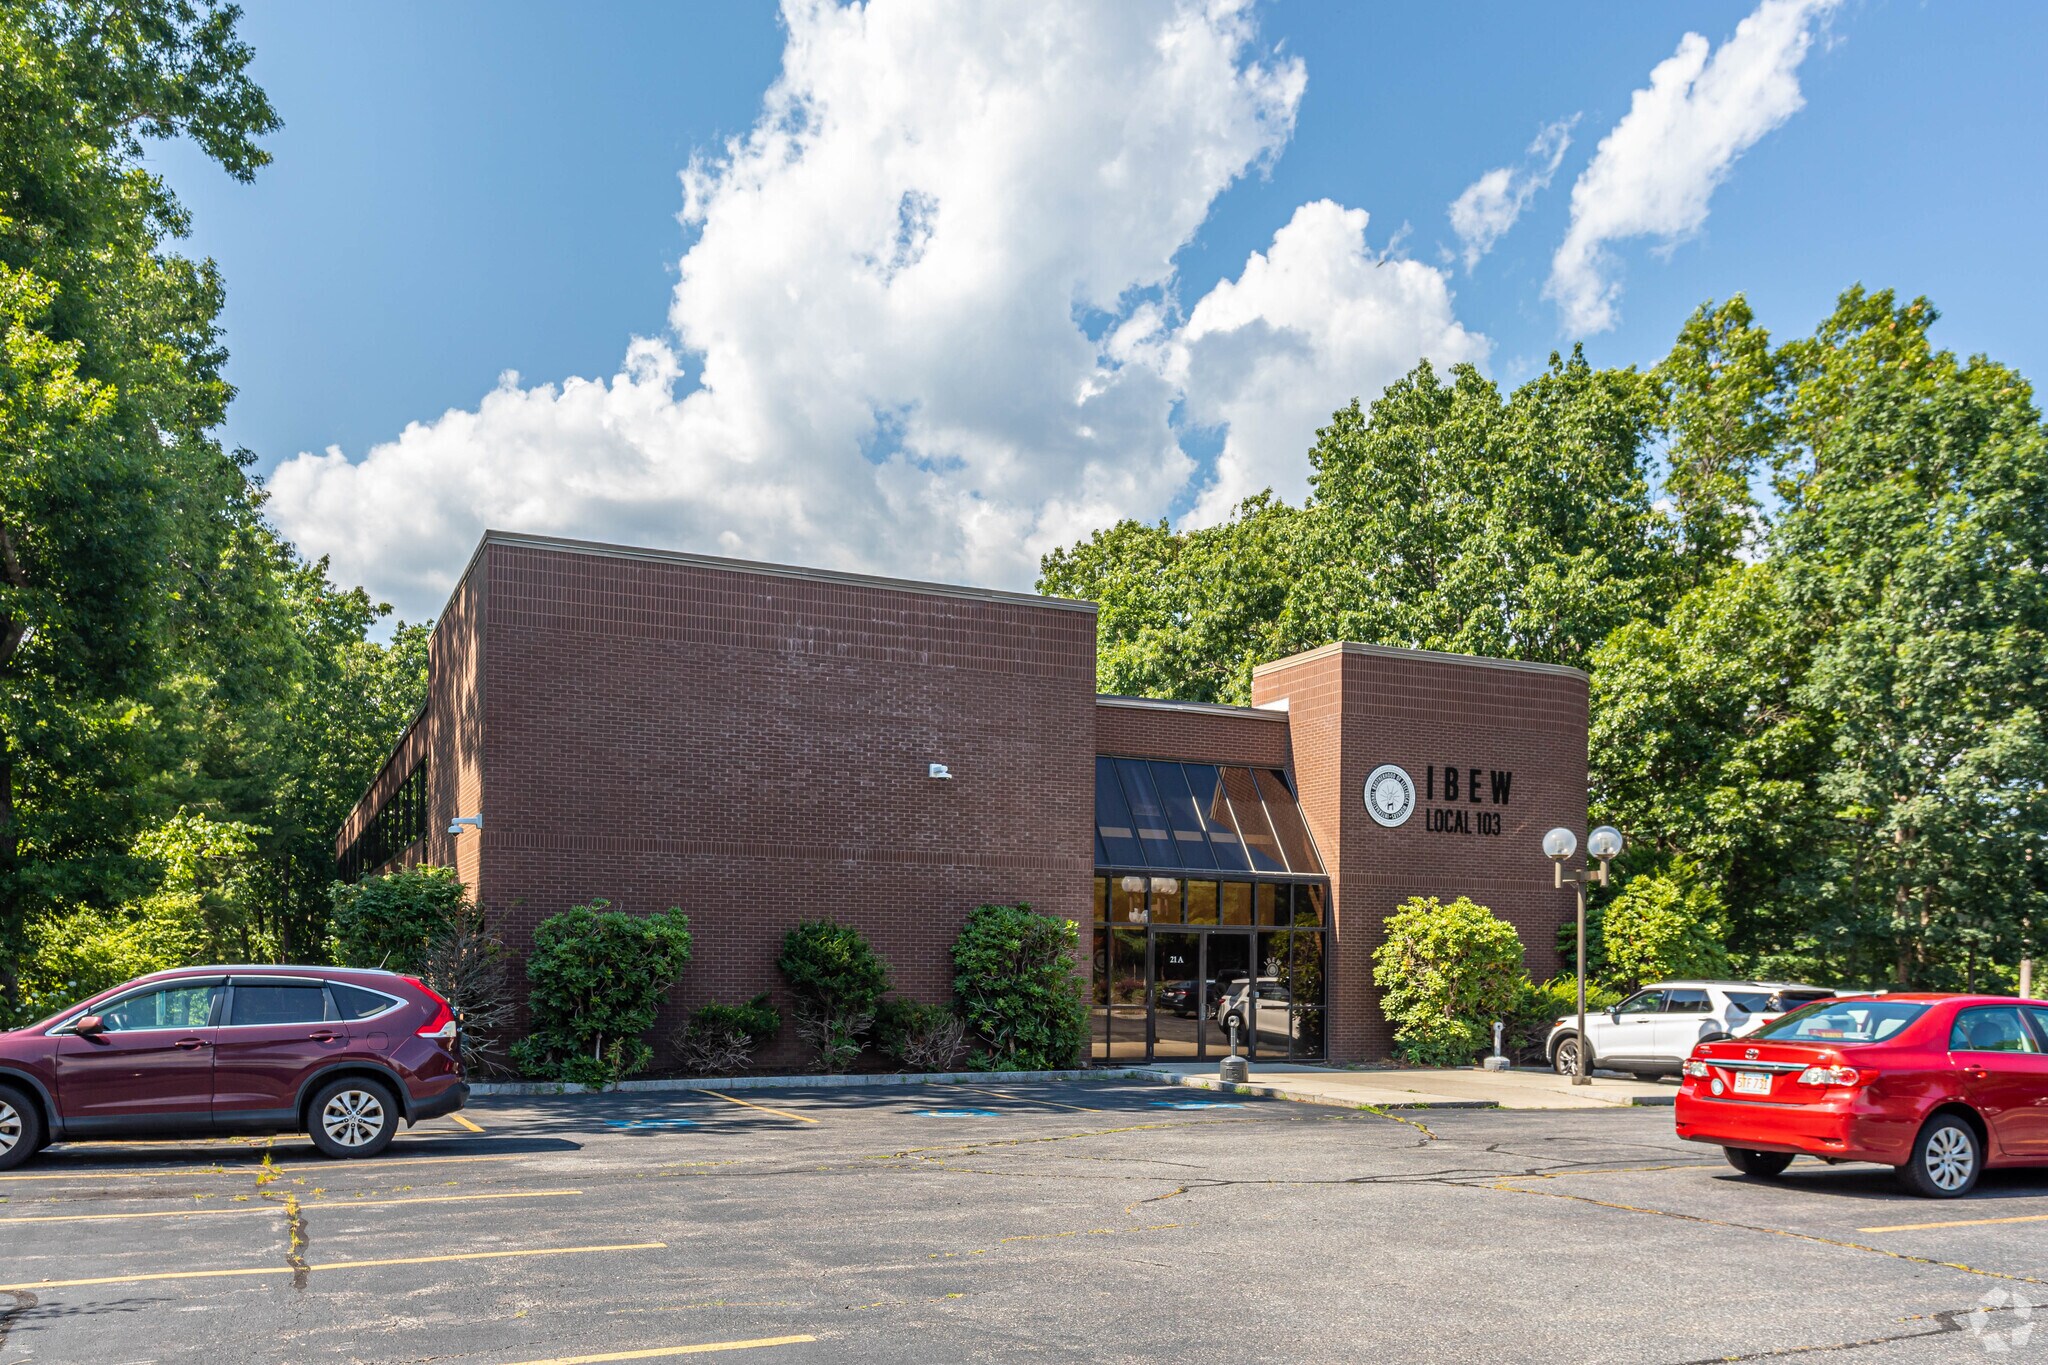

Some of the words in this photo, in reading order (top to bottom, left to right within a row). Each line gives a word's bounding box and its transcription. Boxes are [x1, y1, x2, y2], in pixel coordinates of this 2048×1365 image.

[1427, 766, 1512, 805] IBEW
[1426, 808, 1472, 835] LOCAL
[1476, 811, 1501, 836] 103
[1263, 957, 1282, 966] IBEW
